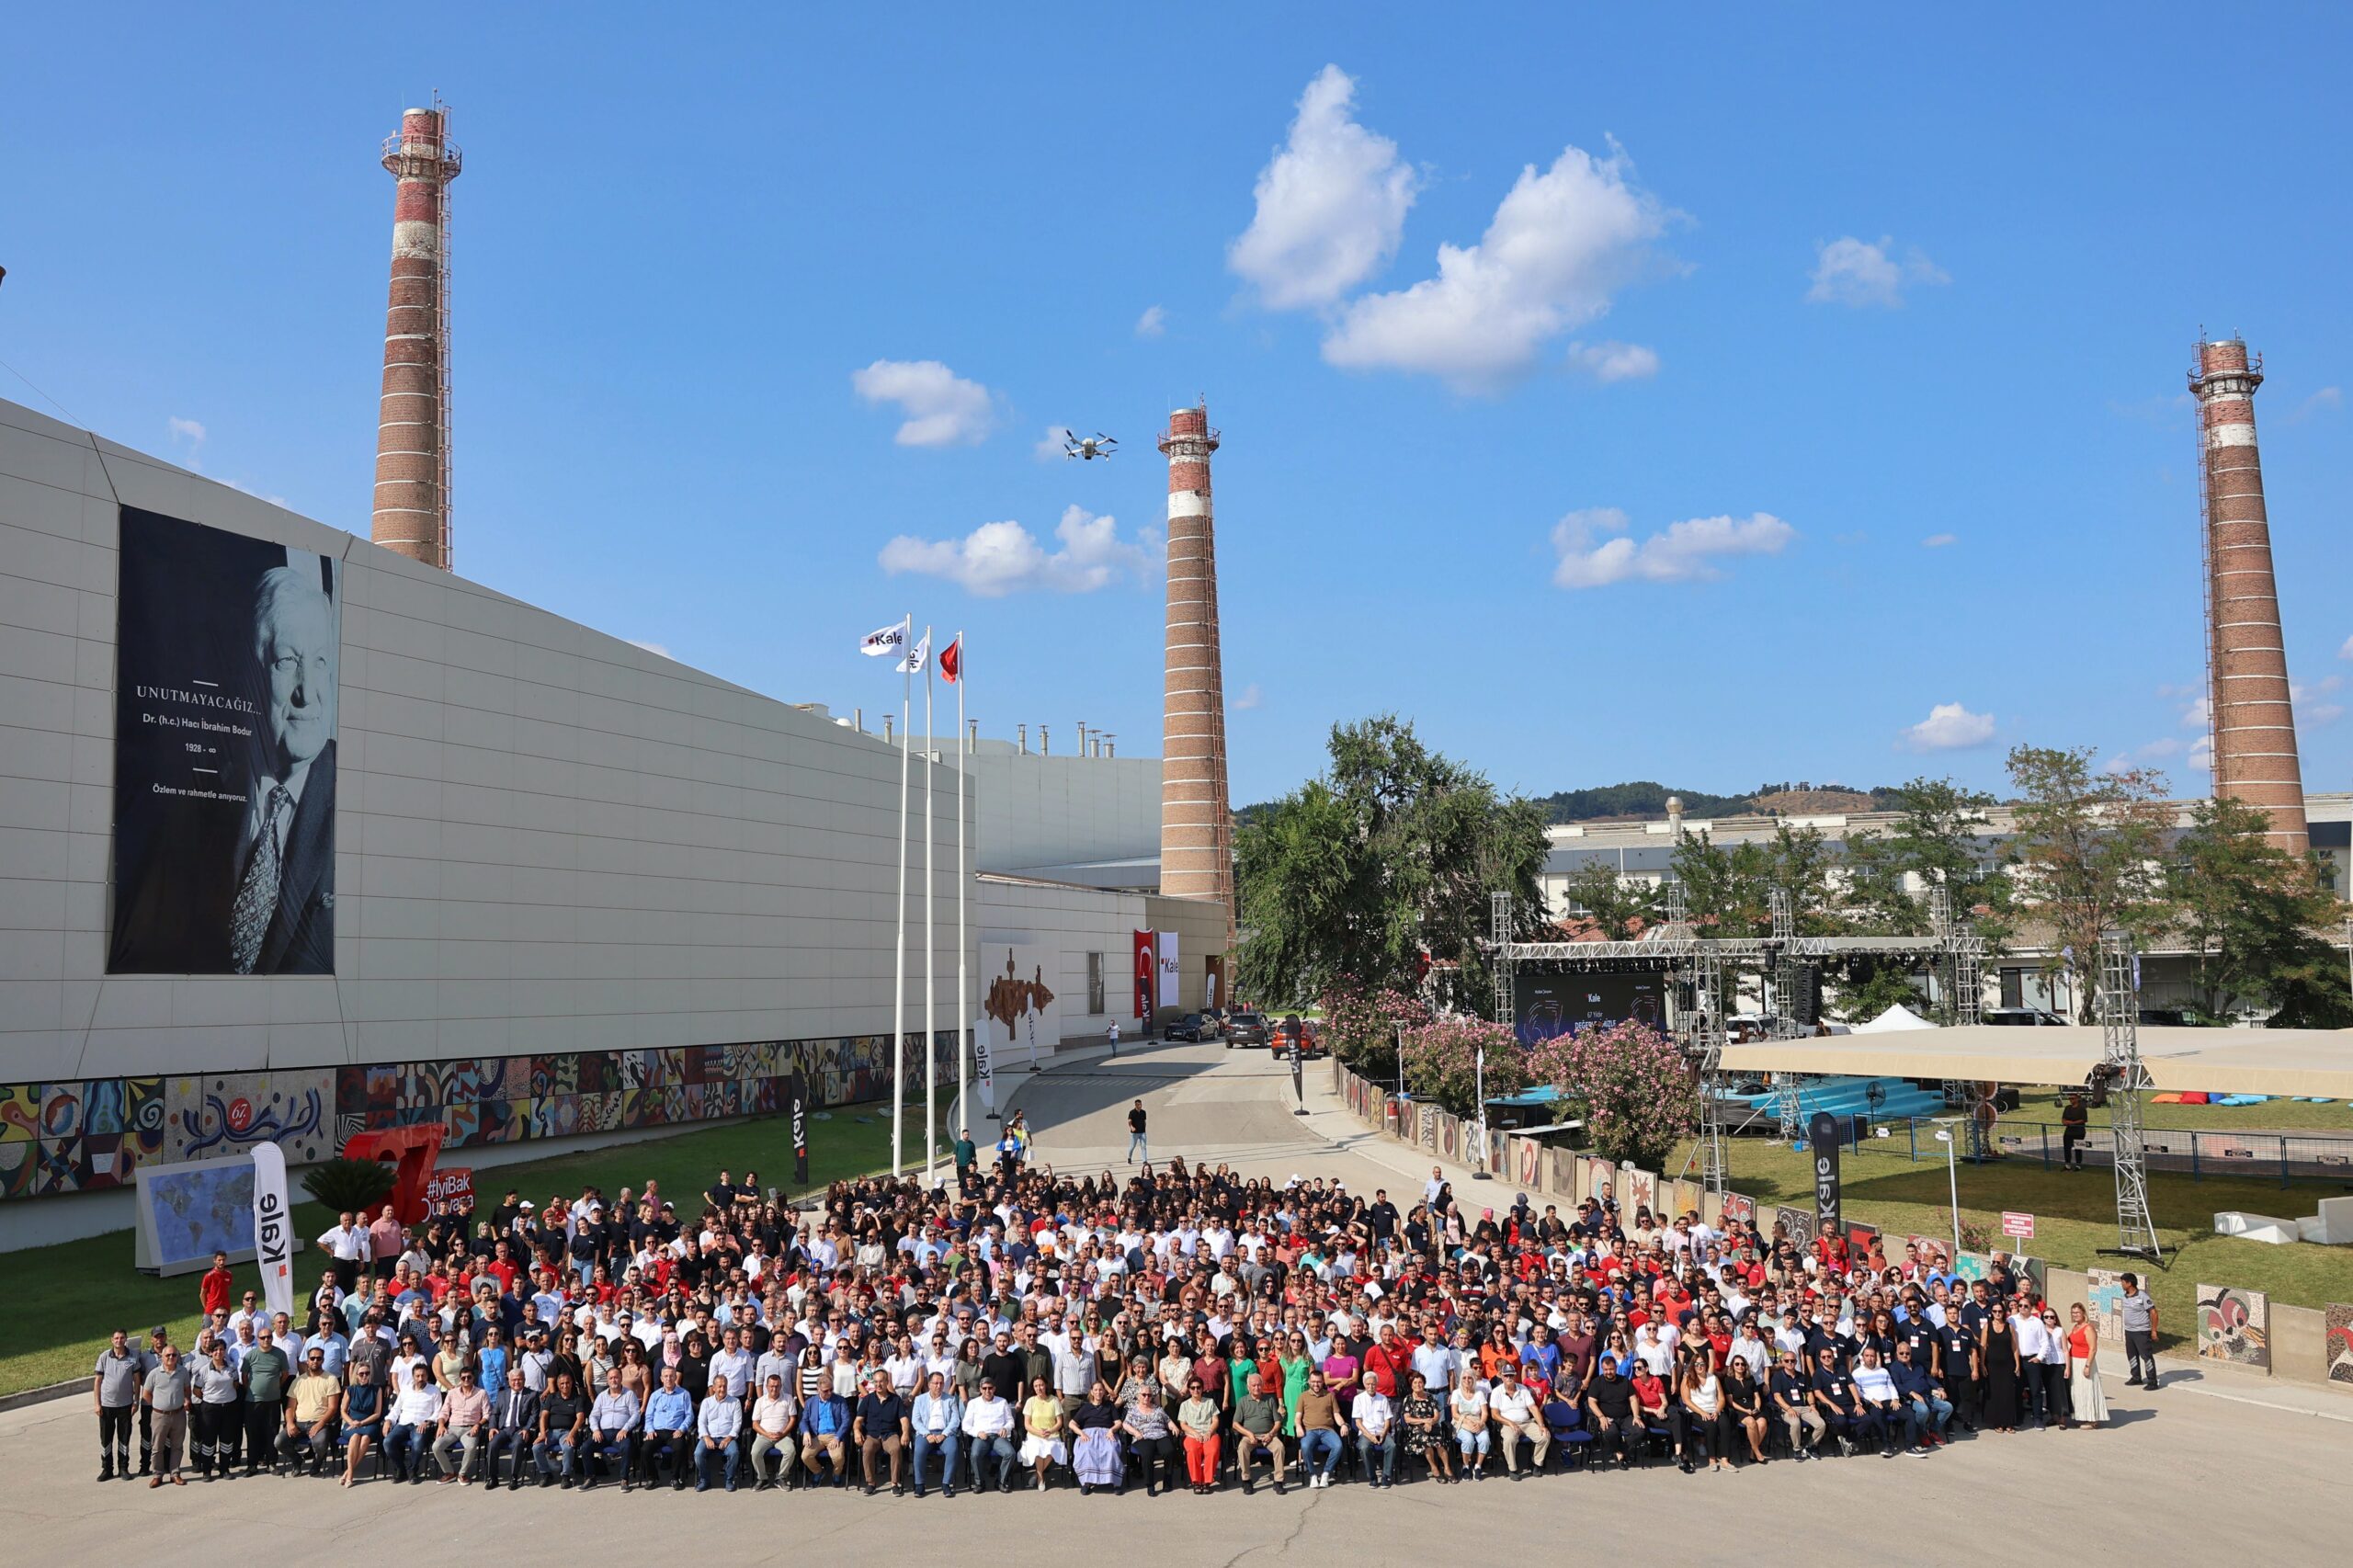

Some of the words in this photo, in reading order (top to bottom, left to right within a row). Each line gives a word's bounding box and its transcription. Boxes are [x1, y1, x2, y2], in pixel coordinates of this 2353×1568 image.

[875, 631, 903, 645] Kale
[137, 686, 261, 715] UNUTMAYACAĞIZ...
[142, 713, 156, 723] Dr.
[159, 715, 179, 728] (h.c.)
[182, 718, 199, 729] Hacı
[201, 718, 231, 733] İbrahim
[232, 725, 252, 736] Bodur
[185, 743, 202, 754] 1928
[153, 783, 176, 795] Özlem
[187, 789, 217, 799] rahmetle
[218, 792, 247, 802] anıyoruz.
[1165, 957, 1178, 973] Kale
[1141, 994, 1150, 1017] Kale
[1587, 993, 1601, 1003] Kale
[976, 1044, 991, 1080] Kale
[232, 1103, 248, 1119] 67.
[793, 1098, 804, 1149] Kale
[426, 1173, 471, 1199] #İyiBak
[1817, 1157, 1836, 1219] Kale
[259, 1193, 286, 1265] Kale
